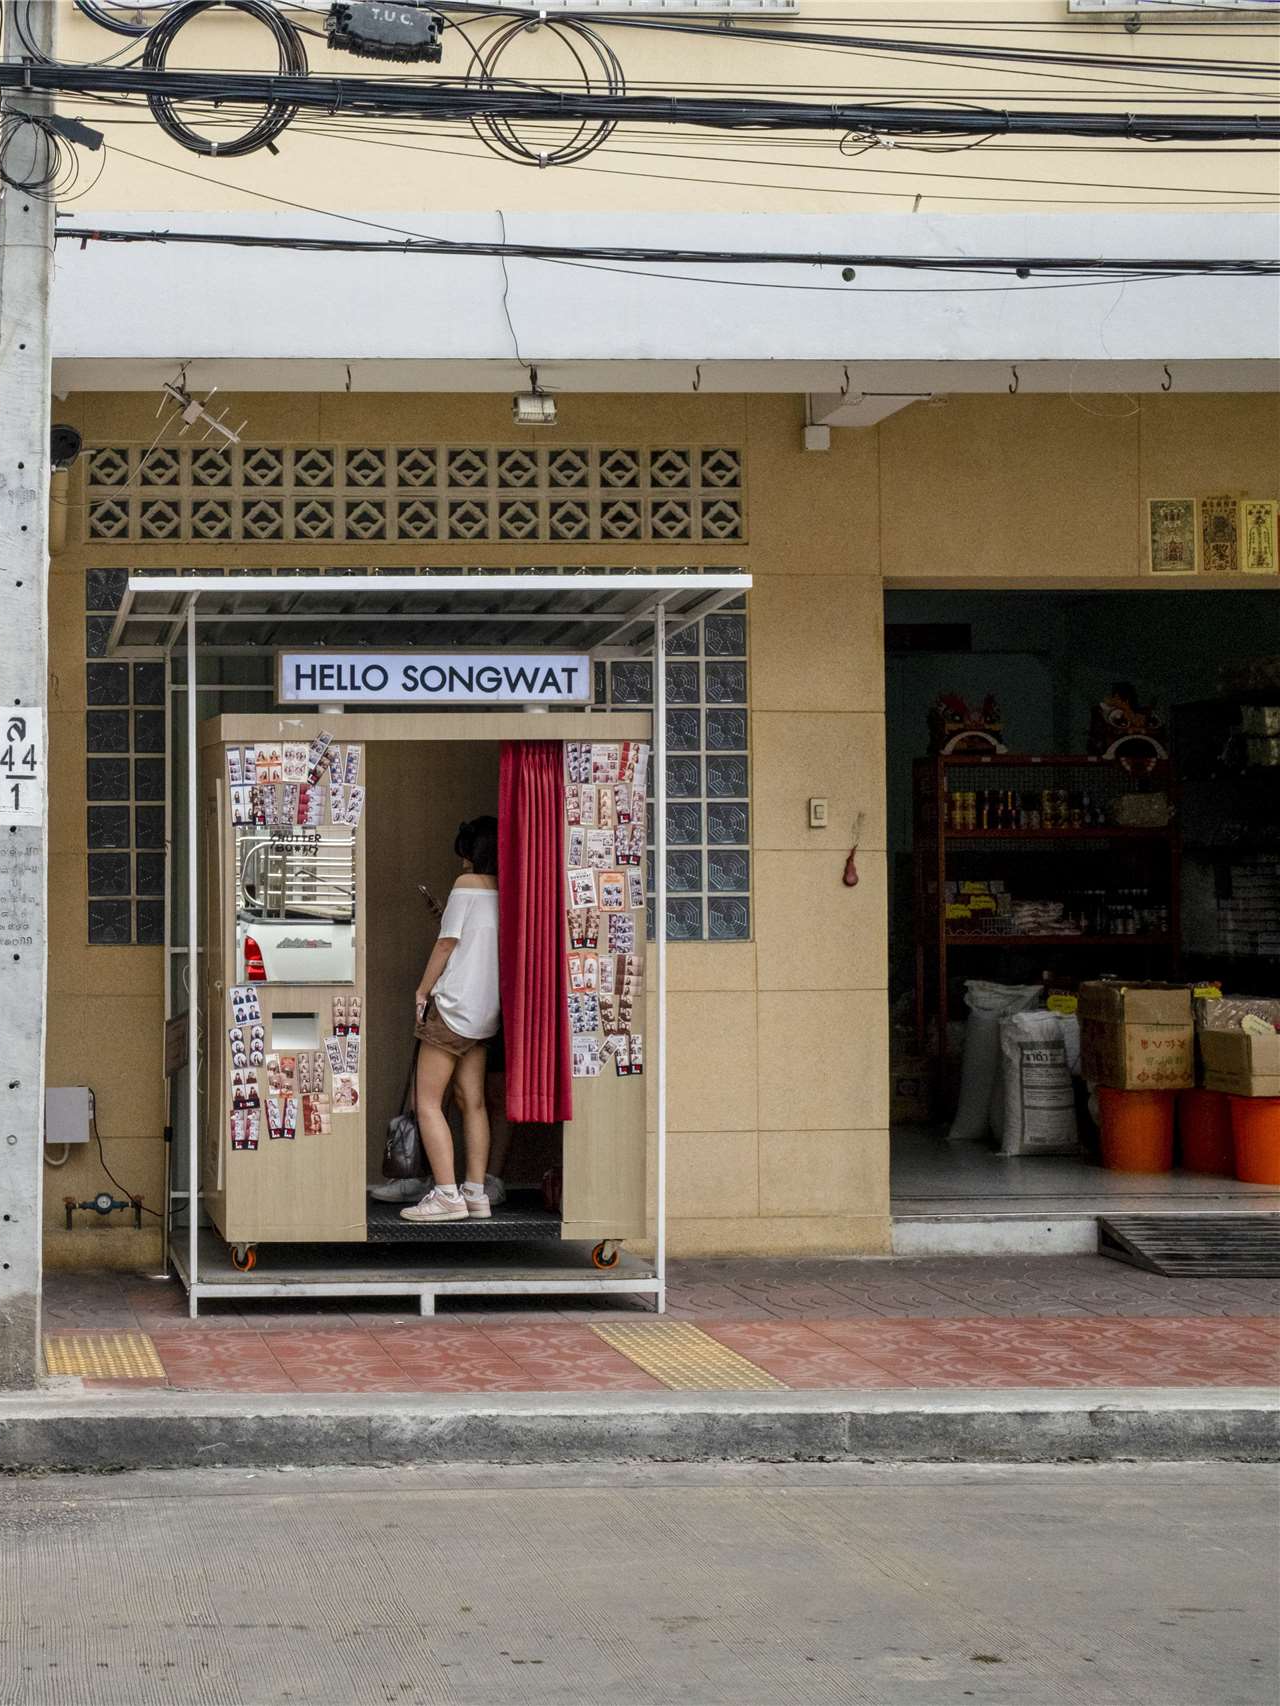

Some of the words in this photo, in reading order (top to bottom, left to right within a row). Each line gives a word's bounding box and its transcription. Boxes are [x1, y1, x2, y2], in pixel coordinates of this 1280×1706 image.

[295, 664, 389, 692] HELLO
[402, 665, 578, 694] SONGWAT
[10, 783, 21, 810] 1
